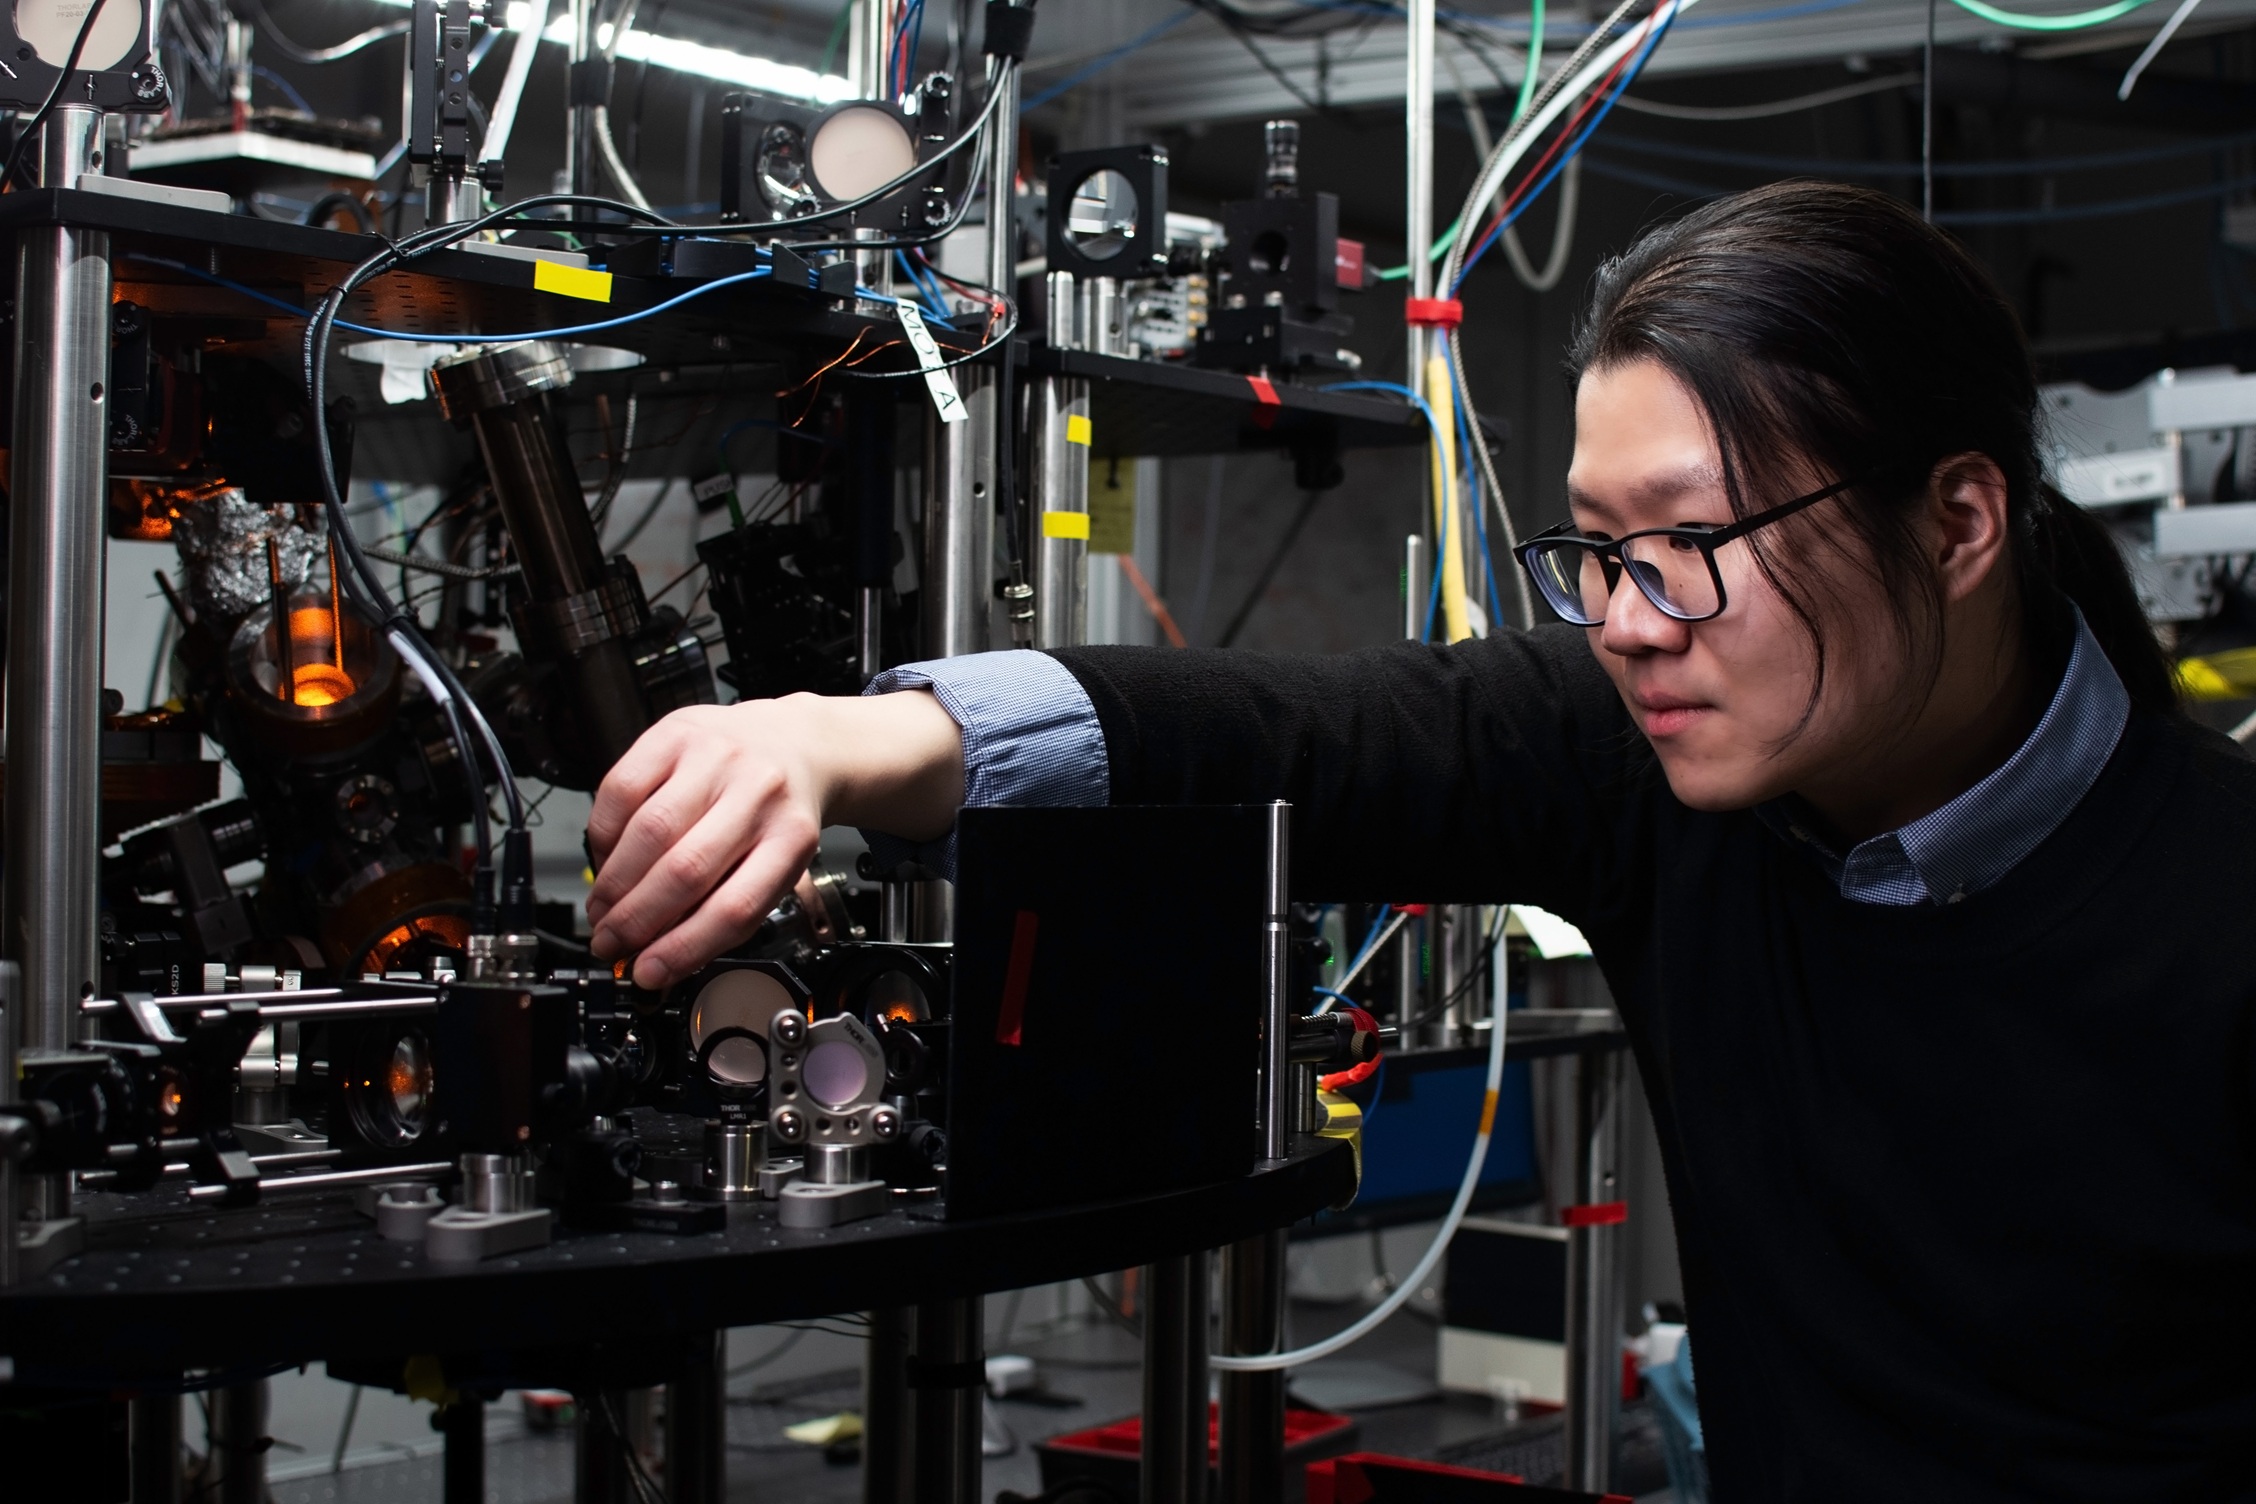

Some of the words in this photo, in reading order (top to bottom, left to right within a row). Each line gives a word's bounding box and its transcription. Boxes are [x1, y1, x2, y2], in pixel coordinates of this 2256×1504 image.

[137, 66, 164, 98] THORLABS
[170, 964, 180, 995] KS2D
[843, 1022, 879, 1058] THOR
[720, 1104, 758, 1112] THOR
